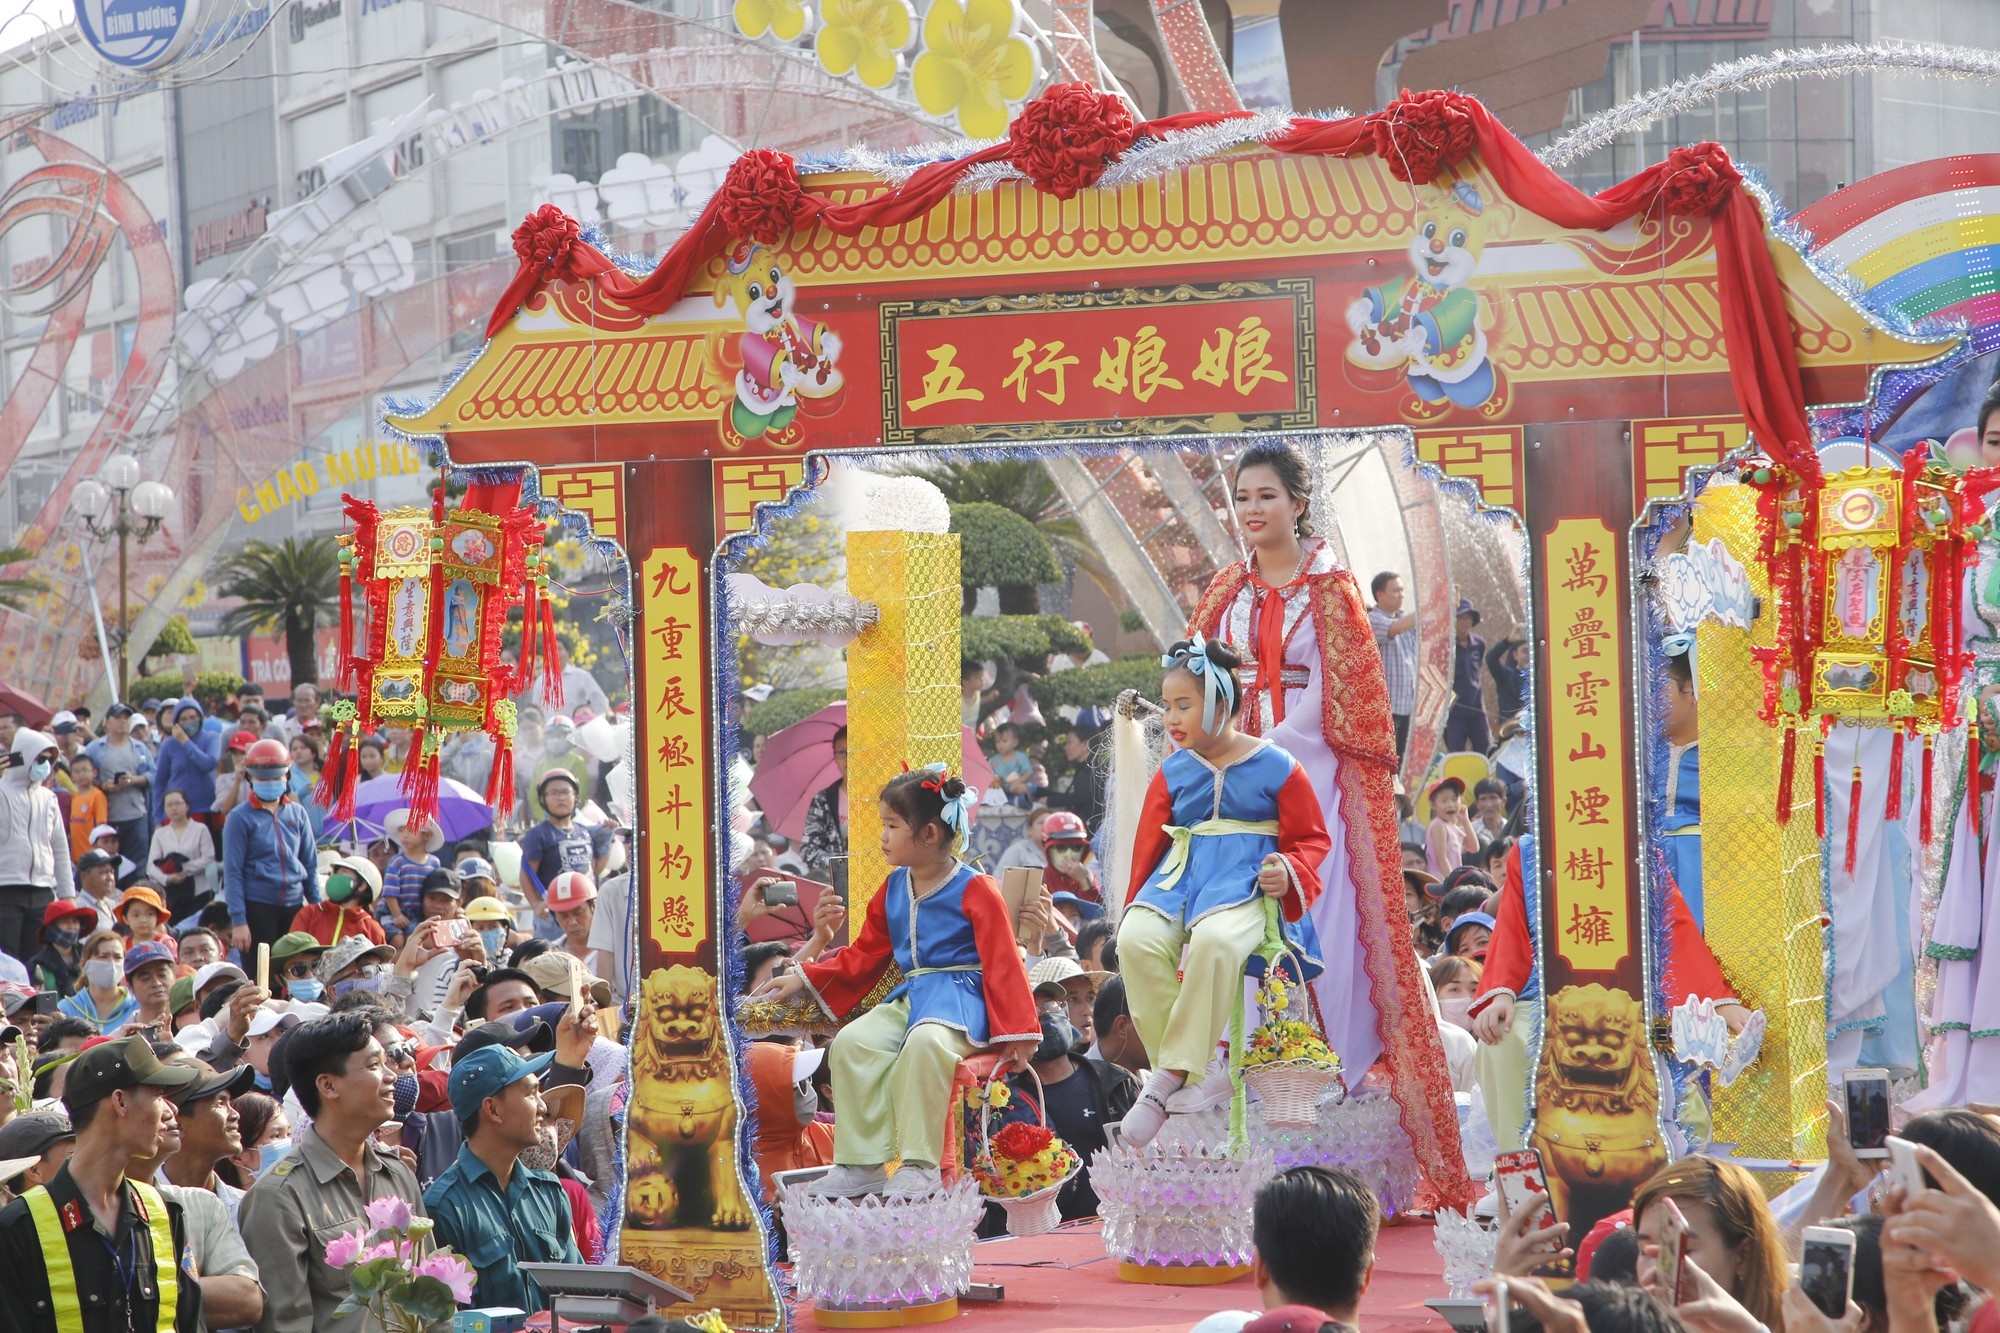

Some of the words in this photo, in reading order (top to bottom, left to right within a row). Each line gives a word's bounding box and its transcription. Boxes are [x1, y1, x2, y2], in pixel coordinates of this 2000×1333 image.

[906, 316, 1289, 412] 五行娘娘
[1561, 541, 1616, 947] 萬疊雲山煙樹擁
